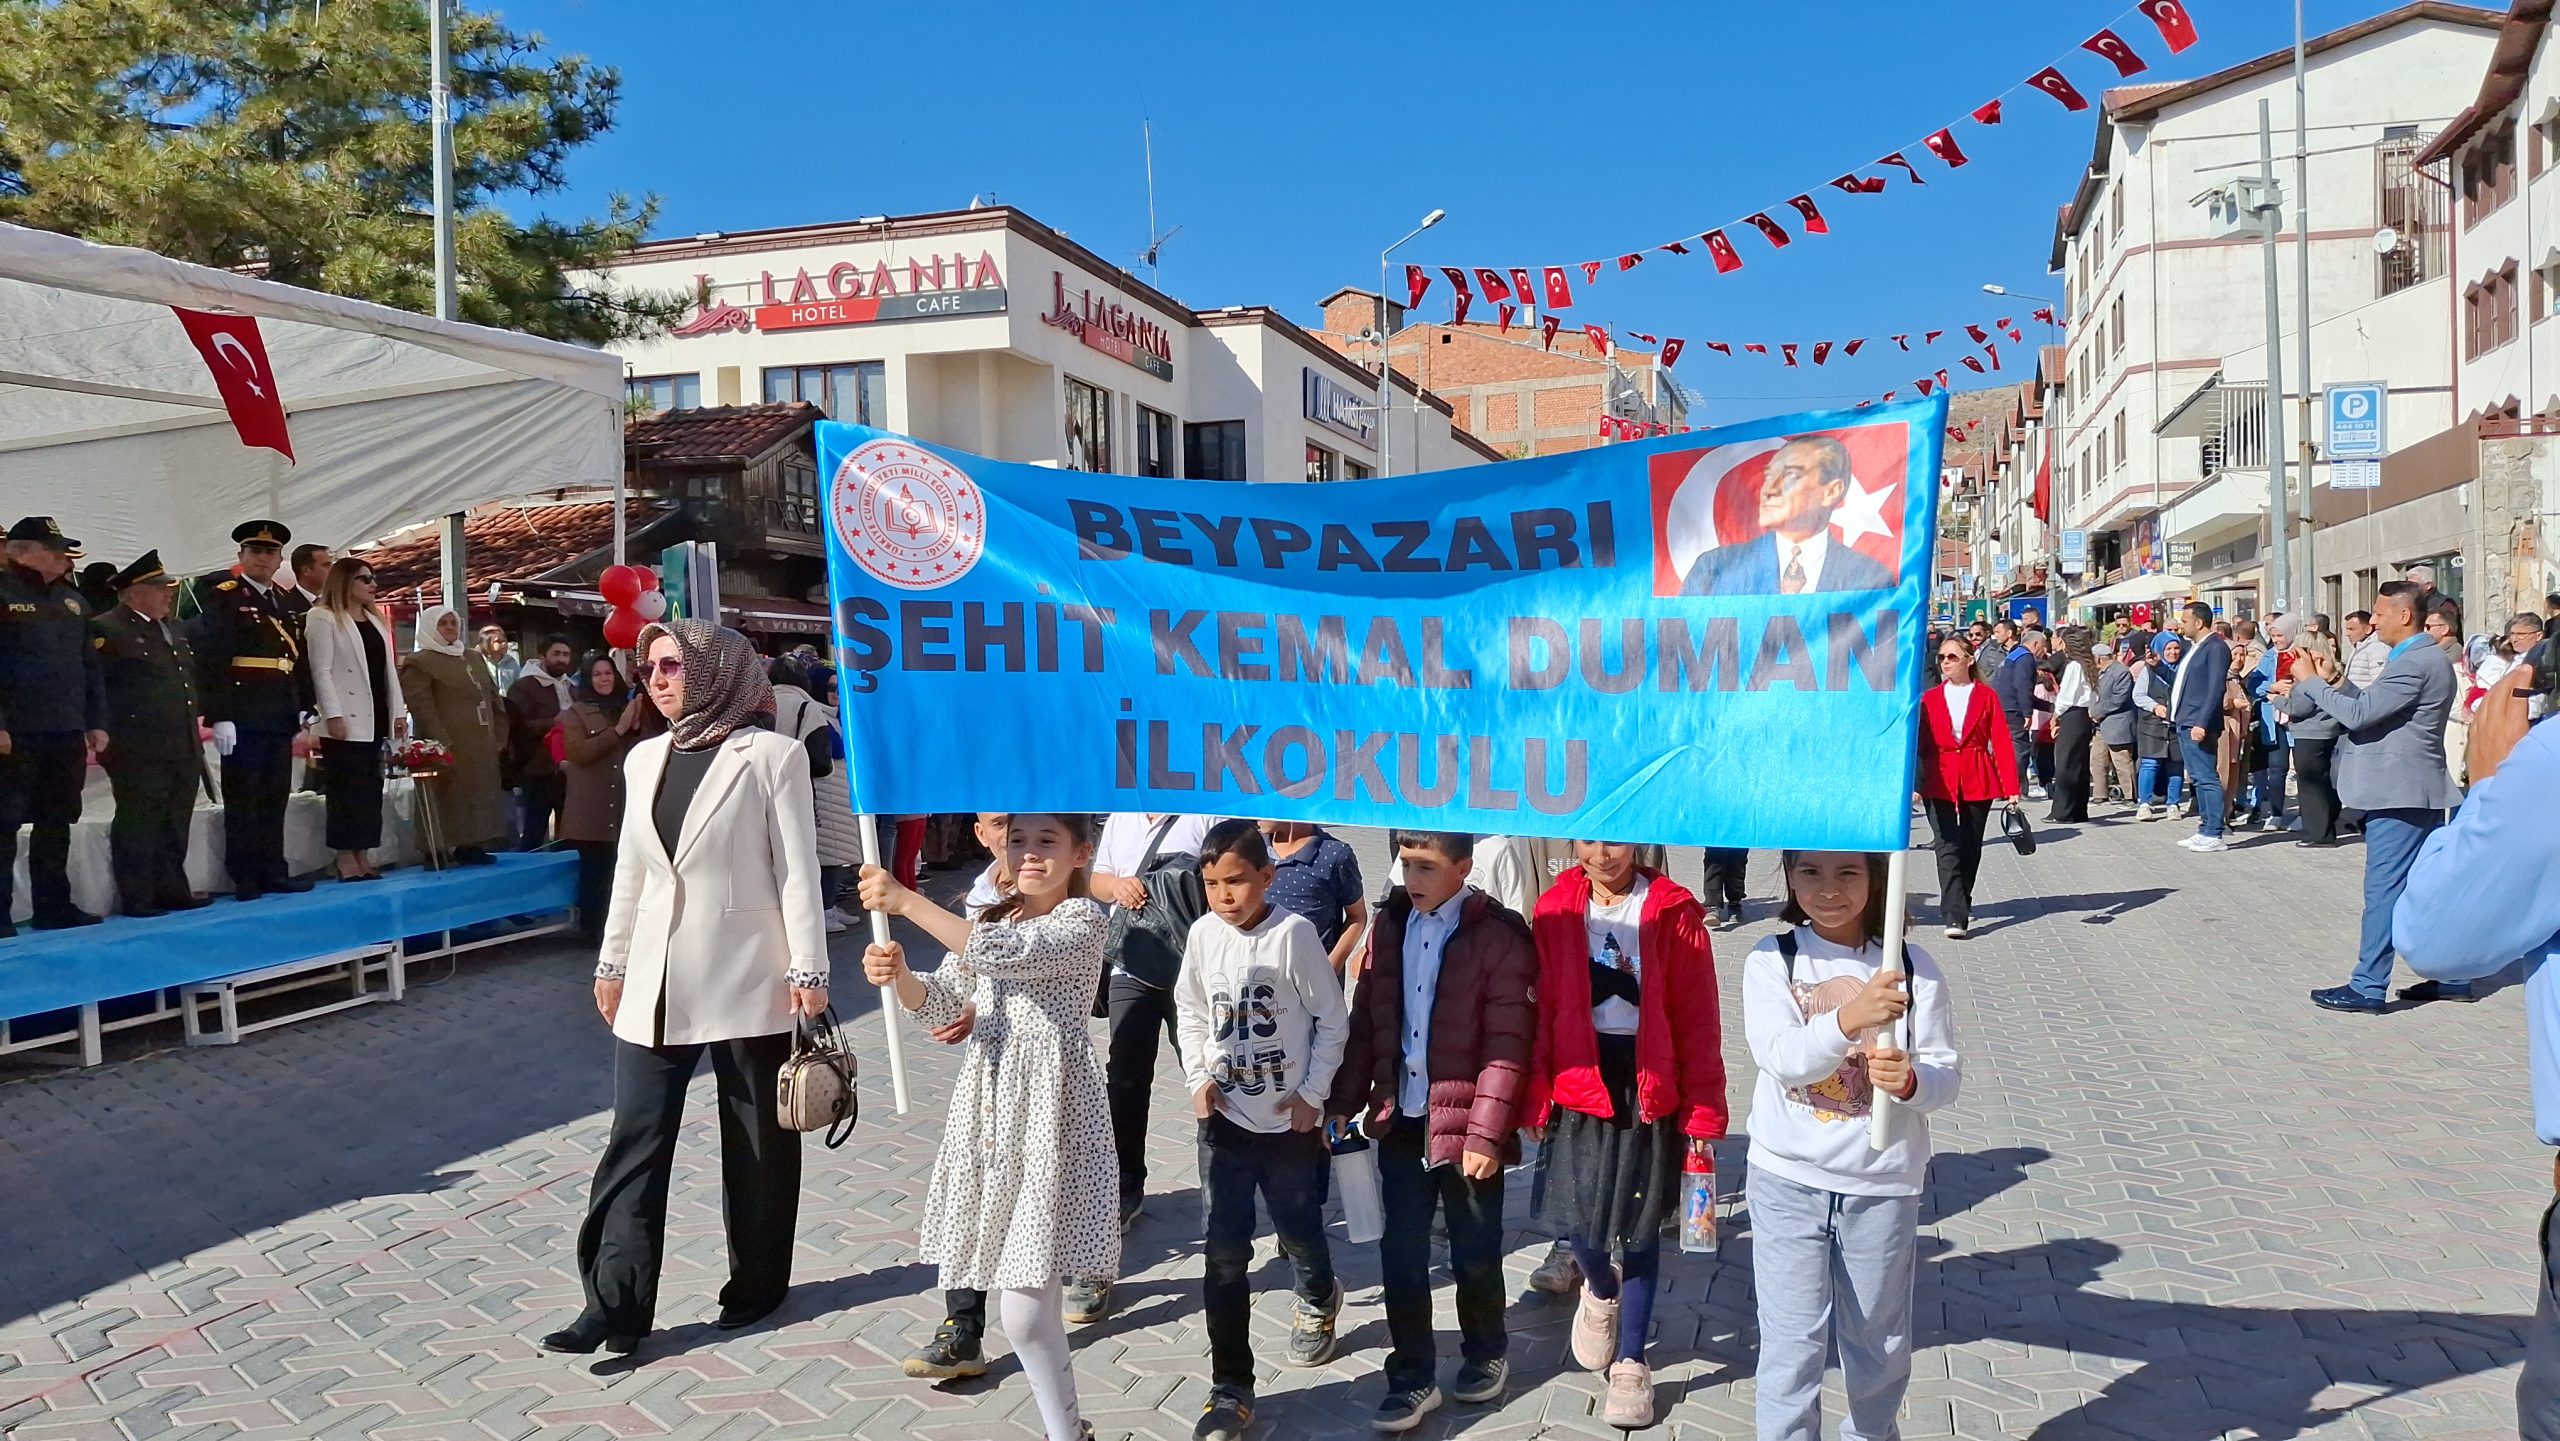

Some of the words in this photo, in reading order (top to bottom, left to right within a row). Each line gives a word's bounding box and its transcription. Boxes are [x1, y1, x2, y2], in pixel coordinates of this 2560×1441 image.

[761, 249, 1001, 306] LAGANIA
[792, 305, 848, 323] HOTEL
[916, 296, 961, 313] CAFE
[1083, 289, 1172, 361] LAGANIA
[1100, 336, 1121, 355] HOTEL
[1144, 355, 1161, 373] CAFE
[2349, 396, 2364, 416] P
[864, 467, 899, 521] CUMHURİYETİ
[931, 479, 954, 513] EĞİTİM
[867, 523, 905, 557] TÜRKİYE
[925, 515, 955, 557] BAKANLIĞI
[1066, 498, 1616, 573] BEYPAZARI
[2171, 545, 2193, 553] Bany
[772, 620, 824, 633] YILDIZ
[835, 583, 1116, 694] ŞEHİT
[1149, 608, 1472, 690] KEMAL
[1507, 608, 1900, 695] DUMAN
[1115, 698, 1588, 816] İLKOKULU
